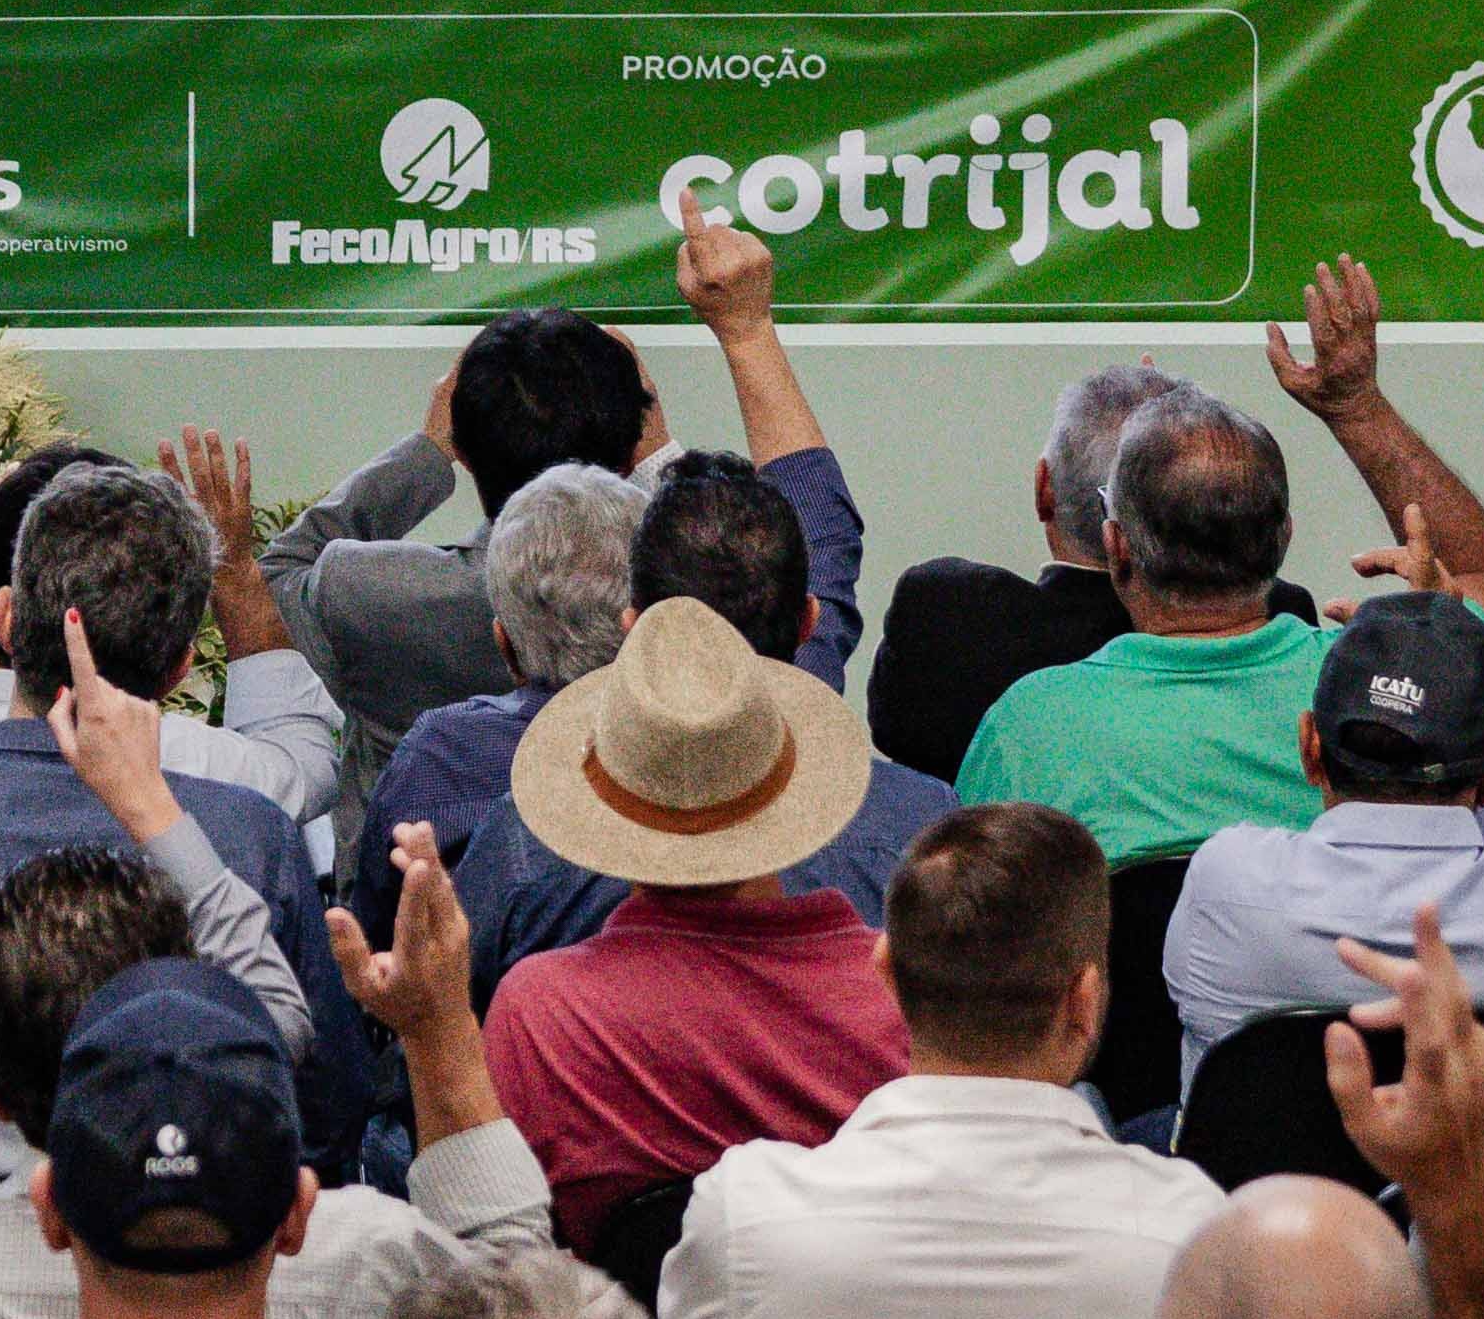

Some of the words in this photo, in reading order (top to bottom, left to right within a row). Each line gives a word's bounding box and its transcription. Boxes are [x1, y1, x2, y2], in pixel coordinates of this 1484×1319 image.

[624, 48, 825, 85] PROMOÇÃO
[659, 113, 1201, 266] cotrijal
[1369, 674, 1425, 701] ICATU
